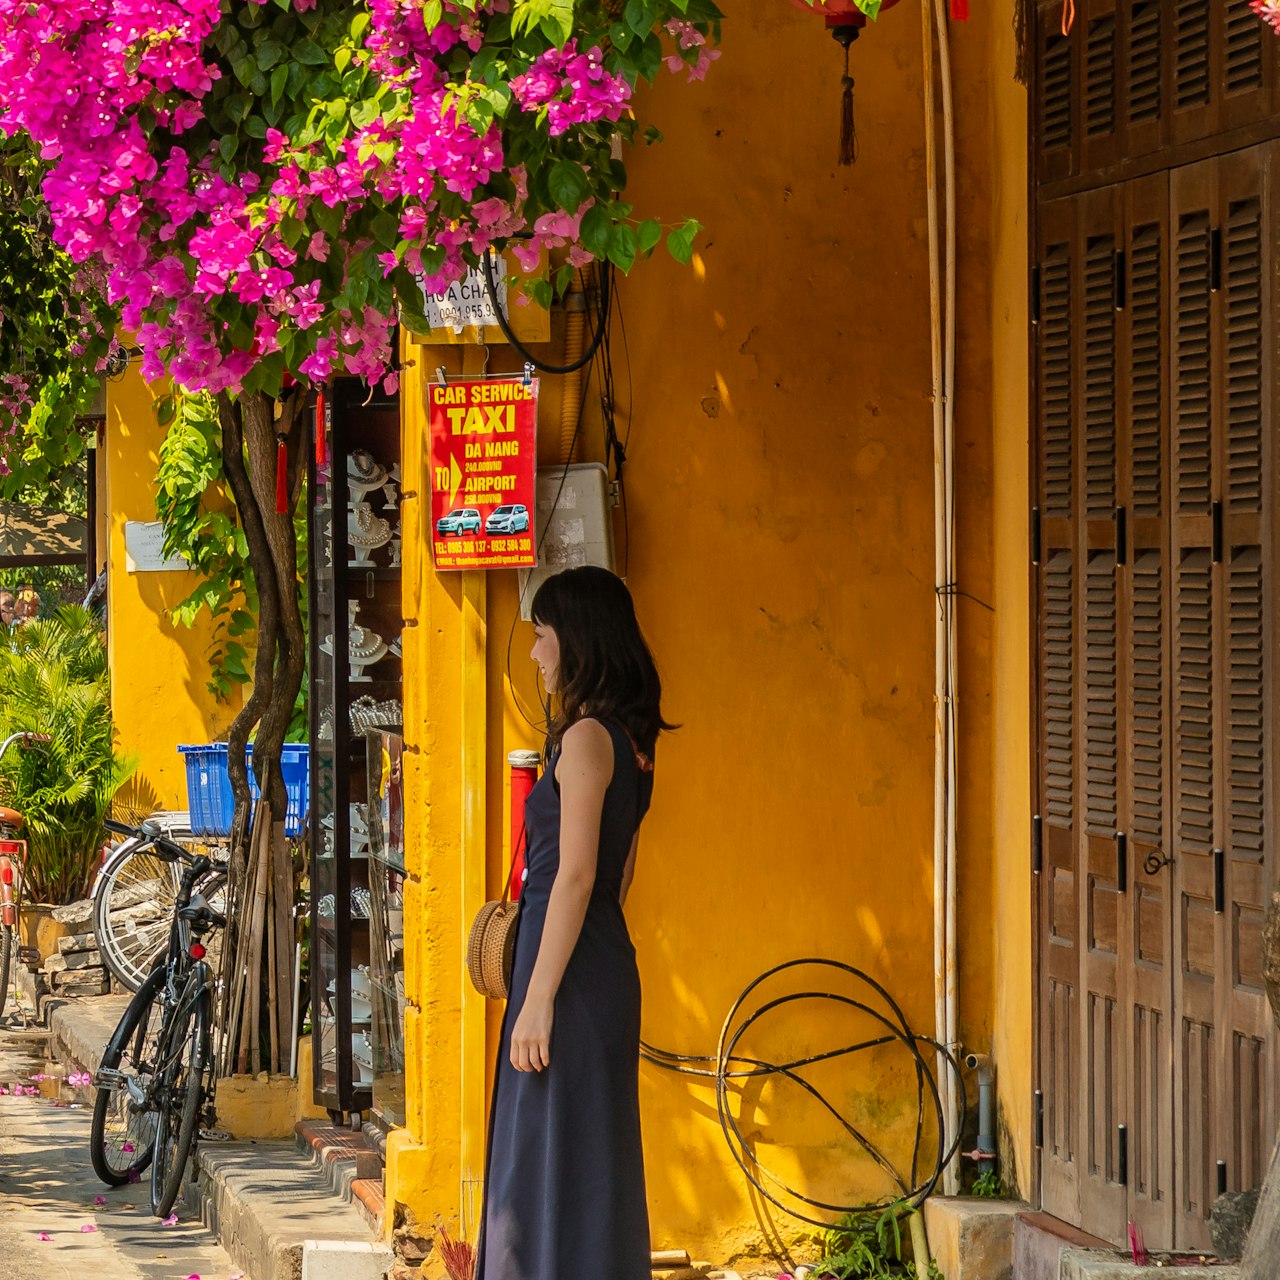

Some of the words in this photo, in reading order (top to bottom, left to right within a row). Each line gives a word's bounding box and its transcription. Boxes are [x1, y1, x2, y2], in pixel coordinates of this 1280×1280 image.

[434, 386, 466, 405] CAR
[471, 383, 533, 403] SERVICE
[446, 405, 516, 436] TAXI
[465, 443, 482, 459] DA
[485, 441, 519, 458] NANG
[435, 467, 450, 491] TO
[464, 475, 517, 492] AIRPORT
[475, 540, 487, 553] 137
